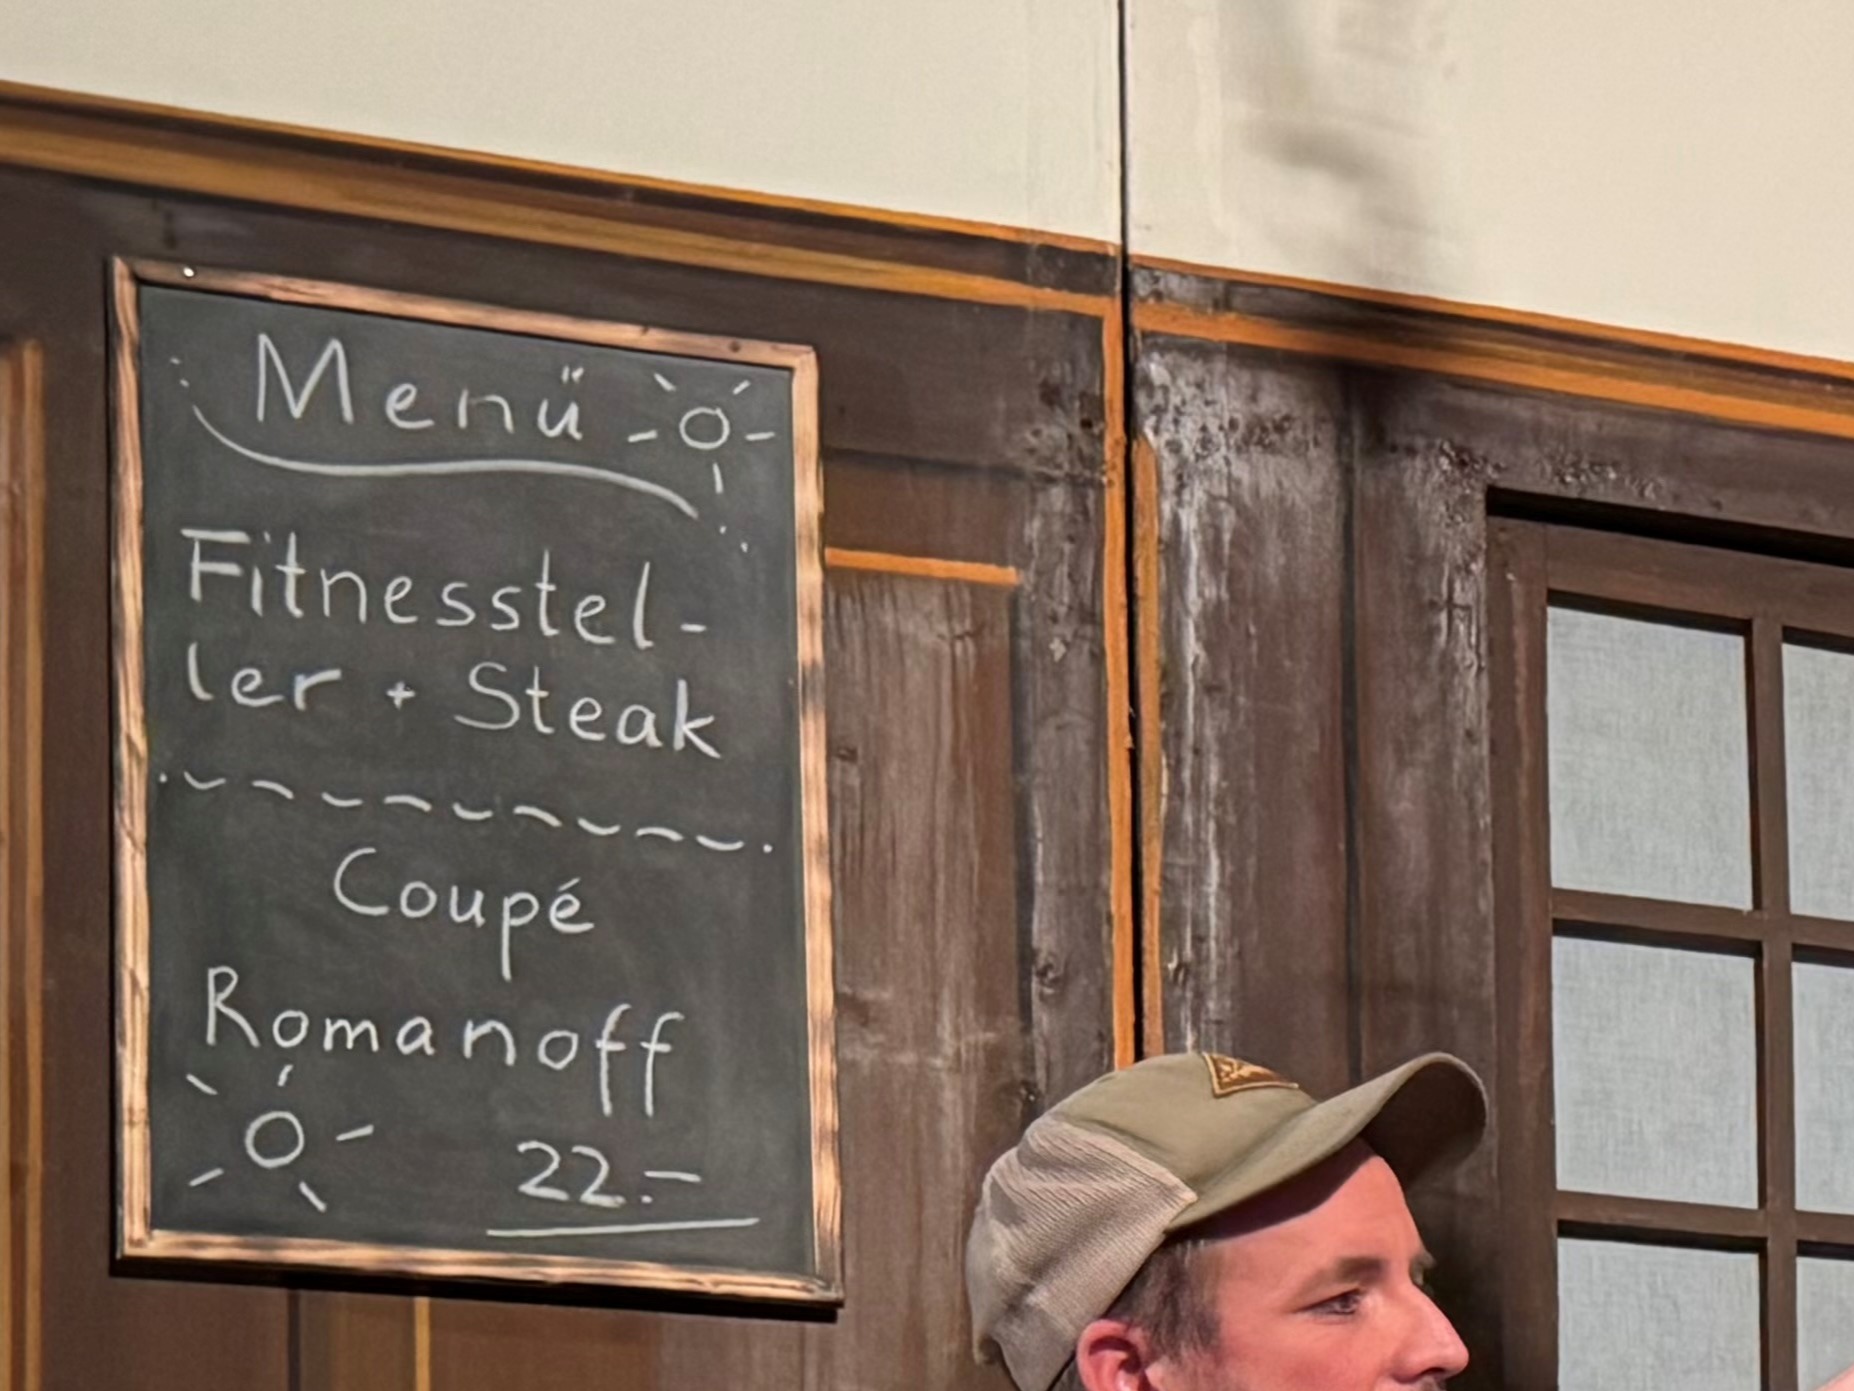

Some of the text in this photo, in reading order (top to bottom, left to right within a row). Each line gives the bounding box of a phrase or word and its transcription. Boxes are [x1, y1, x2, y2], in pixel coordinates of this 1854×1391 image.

[255, 333, 585, 440] Menü
[186, 642, 343, 711] ler
[453, 660, 722, 759] Steak
[332, 847, 596, 981] Coupé
[204, 964, 687, 1117] Romanoff
